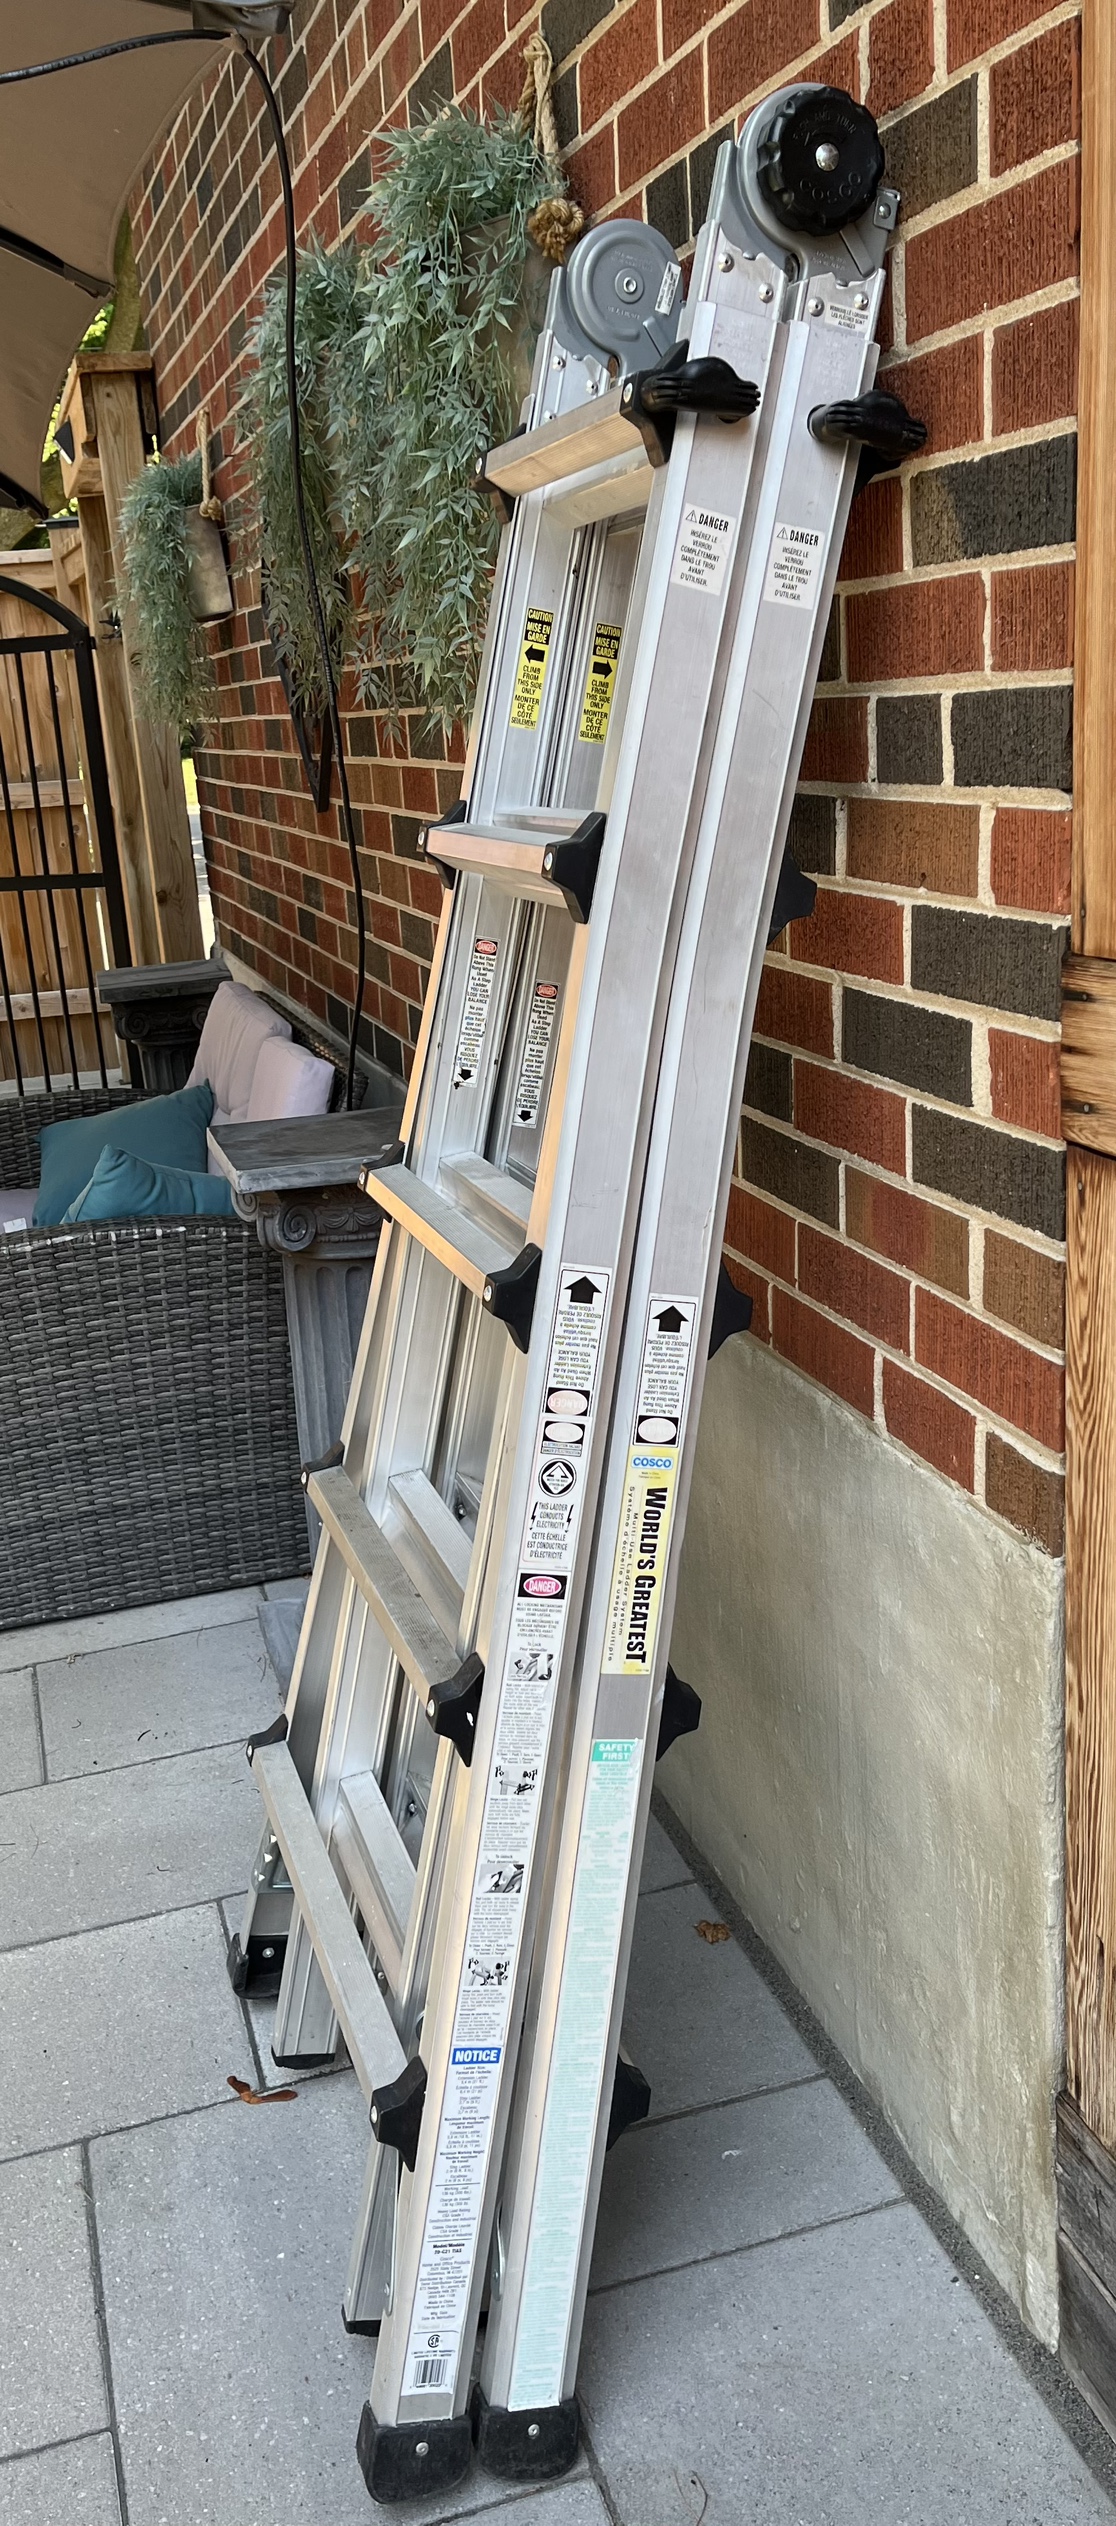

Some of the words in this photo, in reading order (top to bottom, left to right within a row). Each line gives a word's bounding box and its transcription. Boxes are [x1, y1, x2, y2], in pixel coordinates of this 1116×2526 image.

[800, 171, 861, 204] COSCO
[699, 513, 728, 532] DANGER
[690, 529, 711, 542] INSÉREZ
[790, 530, 818, 546] DANGER
[692, 540, 712, 550] VERROU
[681, 555, 694, 564] DANS
[703, 561, 715, 570] TROU
[785, 557, 804, 566] VERROU
[688, 566, 704, 575] AVANT
[775, 572, 787, 580] DANS
[796, 576, 808, 584] TROU
[782, 582, 797, 591] AVANT
[528, 609, 553, 622] CAUTION
[526, 622, 541, 632] MISE
[542, 625, 550, 634] EN
[597, 625, 621, 636] CAUTION
[528, 631, 547, 643] GARDE
[596, 637, 610, 646] MISE
[611, 640, 619, 649] EN
[596, 646, 616, 658] GARDE
[523, 665, 540, 674] CLIMB
[523, 671, 539, 681] FROM
[518, 679, 529, 688] THIS
[530, 681, 542, 690] SIDE
[592, 680, 609, 689] CLIMB
[522, 687, 535, 695] ONLY
[591, 687, 607, 695] FROM
[515, 695, 539, 705] MONTER
[586, 693, 598, 701] THIS
[599, 696, 610, 704] SIDE
[590, 701, 604, 709] ONLY
[583, 709, 608, 719] MONTER
[511, 716, 536, 726] SEULEMENT
[580, 731, 604, 740] SEULEMENT
[551, 1398, 584, 1408] DANGER
[633, 1457, 671, 1468] COSCO
[540, 1512, 564, 1520] CONDUCTS
[536, 1520, 564, 1529] ELECTRICITY
[637, 1487, 668, 1570] WORLD'S
[547, 1532, 565, 1541] ÉCHELLE
[628, 1512, 638, 1559] Multi-Use
[537, 1542, 567, 1550] CONDUCTRICE
[624, 1564, 632, 1596] Ladder
[529, 1580, 556, 1593] DANGER
[619, 1601, 627, 1635] System
[626, 1574, 657, 1664] GREATEST
[608, 1621, 617, 1661] multiple
[455, 2050, 498, 2062] NOTICE
